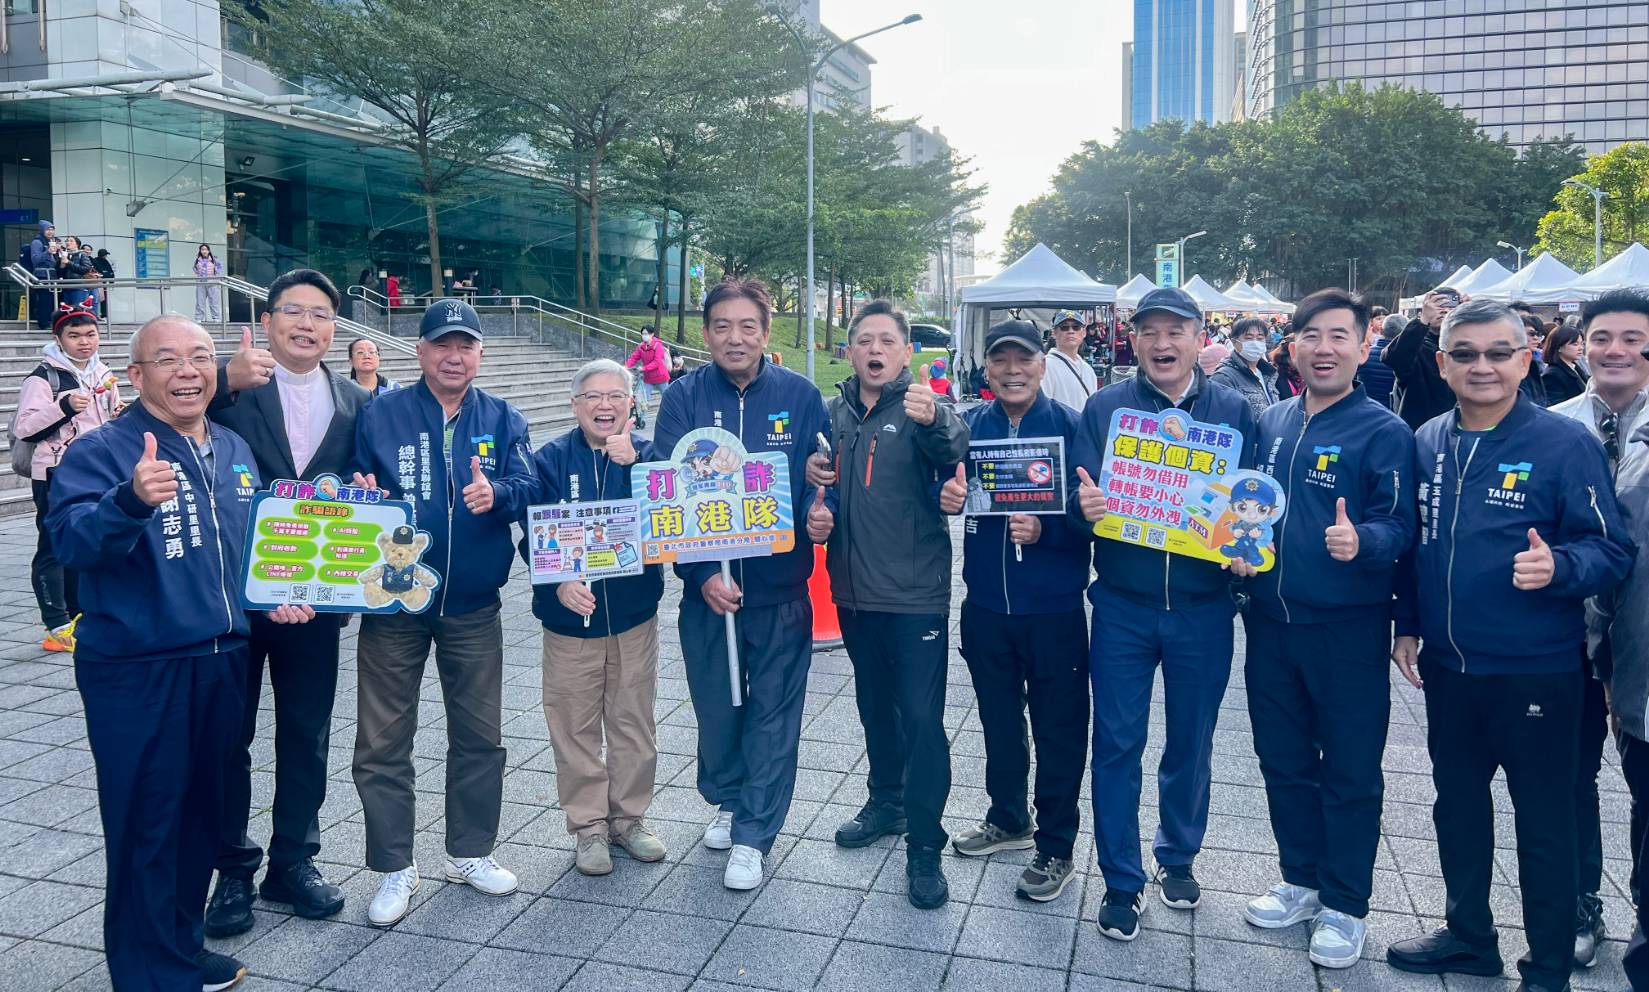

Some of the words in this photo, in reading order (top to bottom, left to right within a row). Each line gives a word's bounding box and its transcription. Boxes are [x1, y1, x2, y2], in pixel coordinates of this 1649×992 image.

[1163, 262, 1173, 288] 南港
[767, 432, 792, 441] TAIPEI
[1119, 413, 1159, 435] 打詐
[1187, 427, 1233, 449] 南港隊
[398, 445, 416, 489] 總幹事
[419, 432, 431, 500] 南港區里長聯誼會
[1112, 460, 1189, 489] 帳號勿借用
[1307, 469, 1336, 483] TAIPEI
[275, 481, 316, 500] 打詐
[336, 487, 381, 503] 南港隊
[1108, 478, 1185, 507] 轉帳要小心
[1488, 488, 1525, 502] TAIPEI
[576, 505, 611, 518] 注意事項
[649, 496, 779, 538] 南港隊
[1106, 496, 1182, 526] 個資勿外洩
[160, 496, 185, 559] 謝志勇
[1188, 516, 1209, 539] ATM
